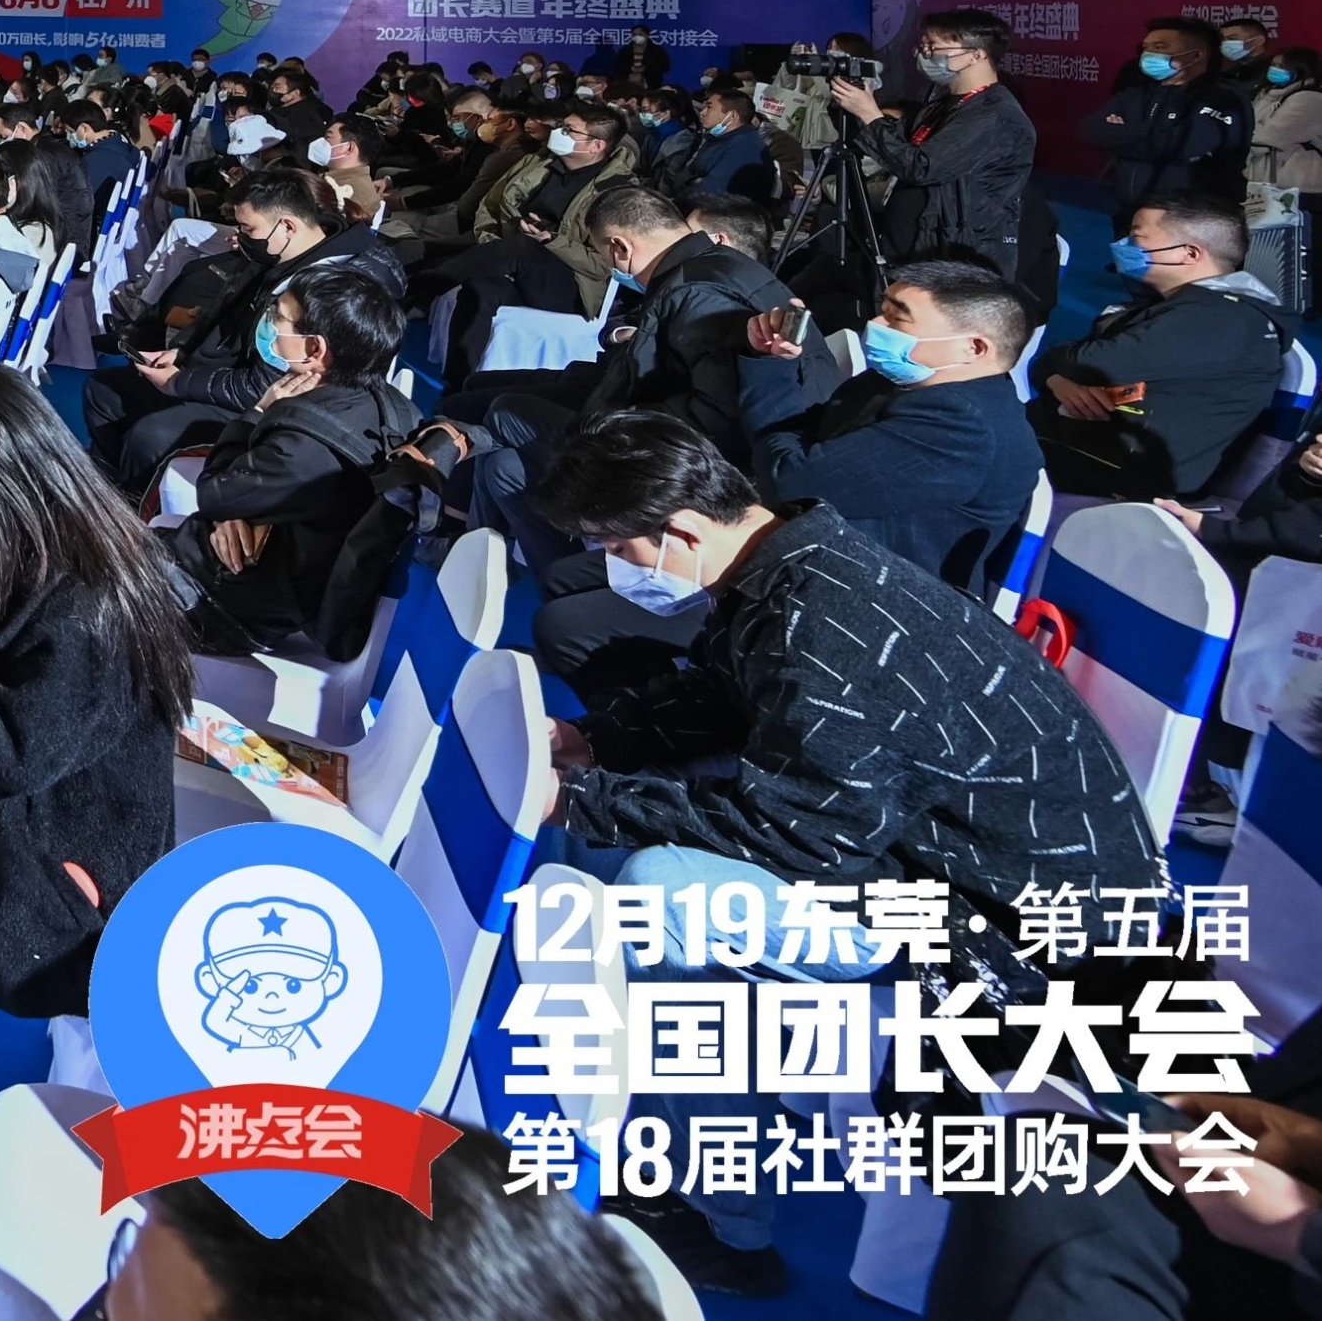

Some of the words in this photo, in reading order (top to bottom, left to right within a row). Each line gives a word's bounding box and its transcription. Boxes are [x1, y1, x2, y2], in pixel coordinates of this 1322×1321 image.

[1013, 1, 1080, 42] 年终盛典
[998, 51, 1100, 83] 暨第5届全国团长对接会
[1199, 106, 1233, 125] FILA
